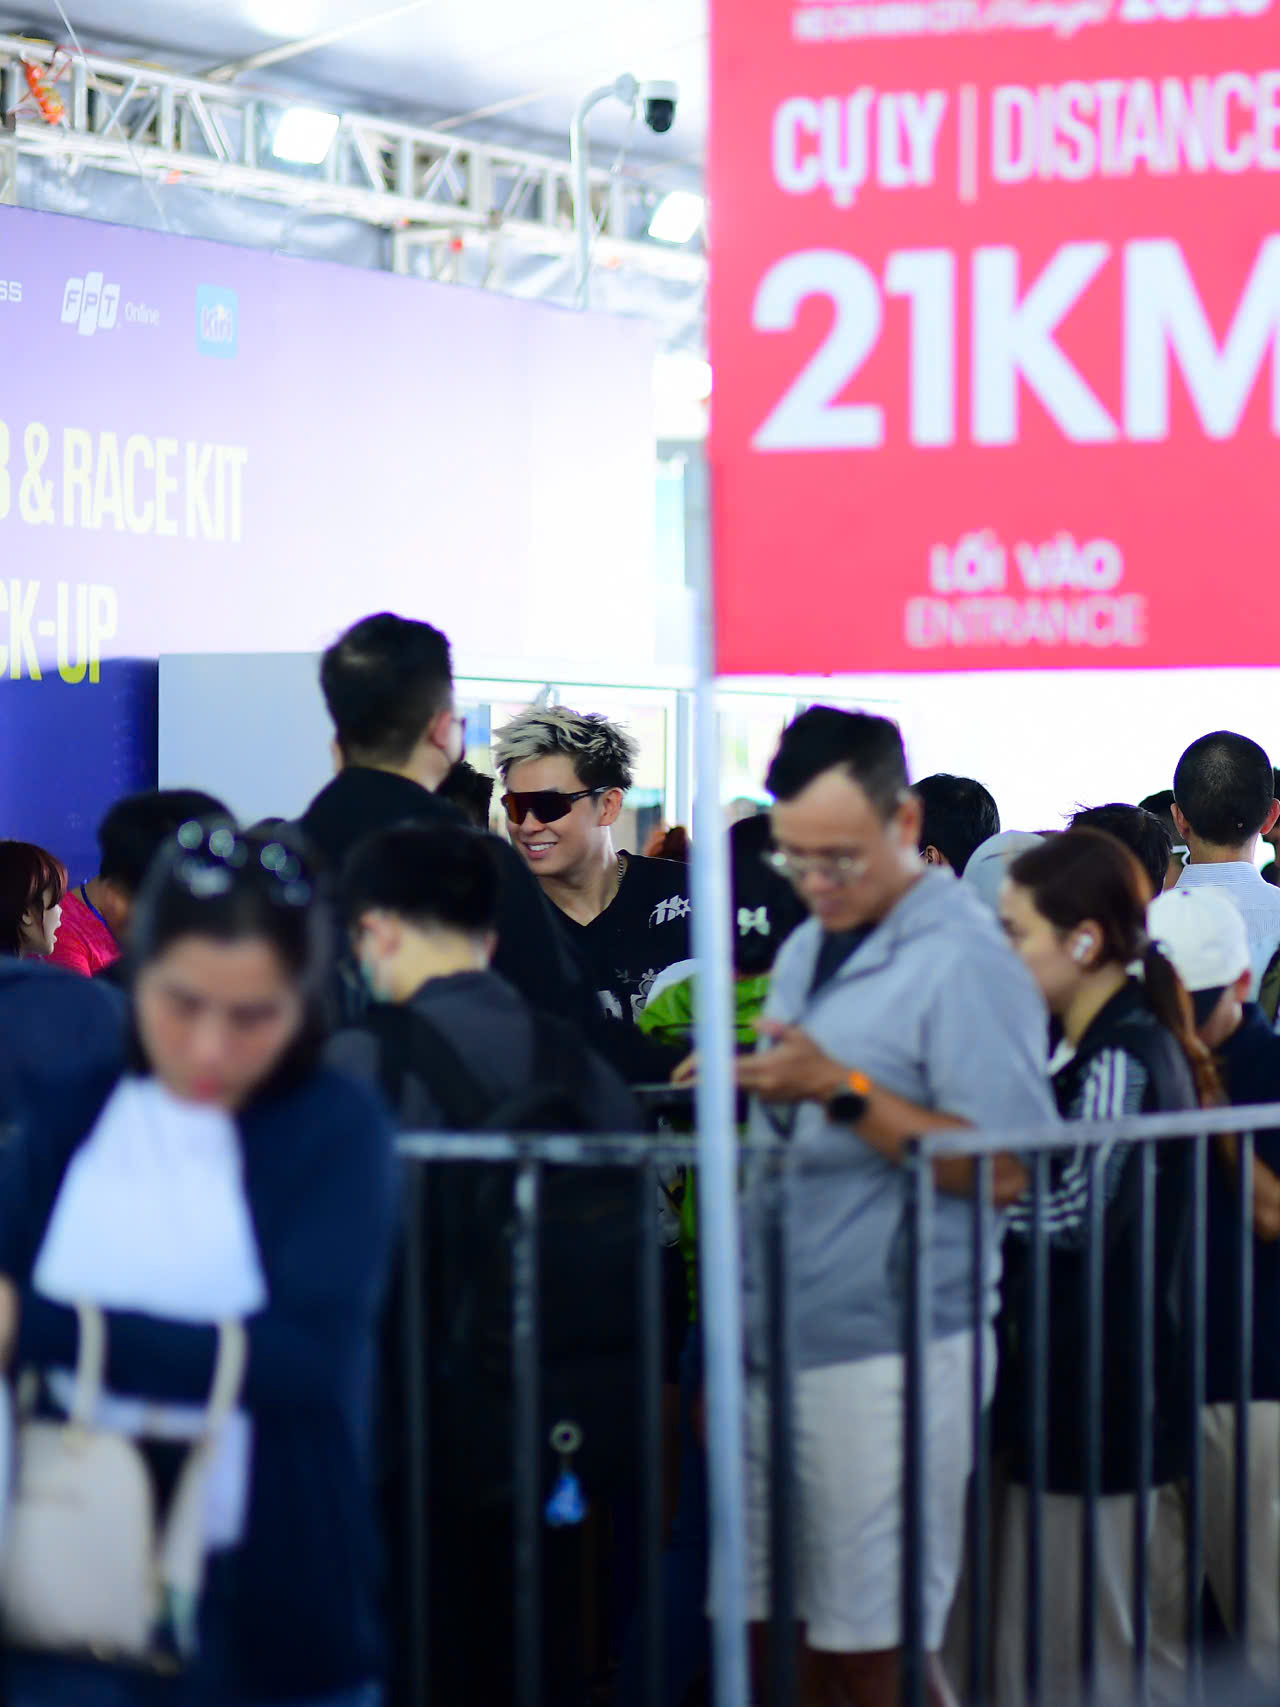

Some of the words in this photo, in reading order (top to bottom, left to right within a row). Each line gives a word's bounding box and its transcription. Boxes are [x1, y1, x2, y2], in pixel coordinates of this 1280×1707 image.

[878, 90, 948, 188] LY
[62, 276, 120, 332] FPT
[124, 302, 160, 326] Online
[19, 421, 54, 526] &
[63, 427, 178, 536] RACE
[185, 441, 248, 542] KIT
[904, 593, 1147, 649] ENTRANCE
